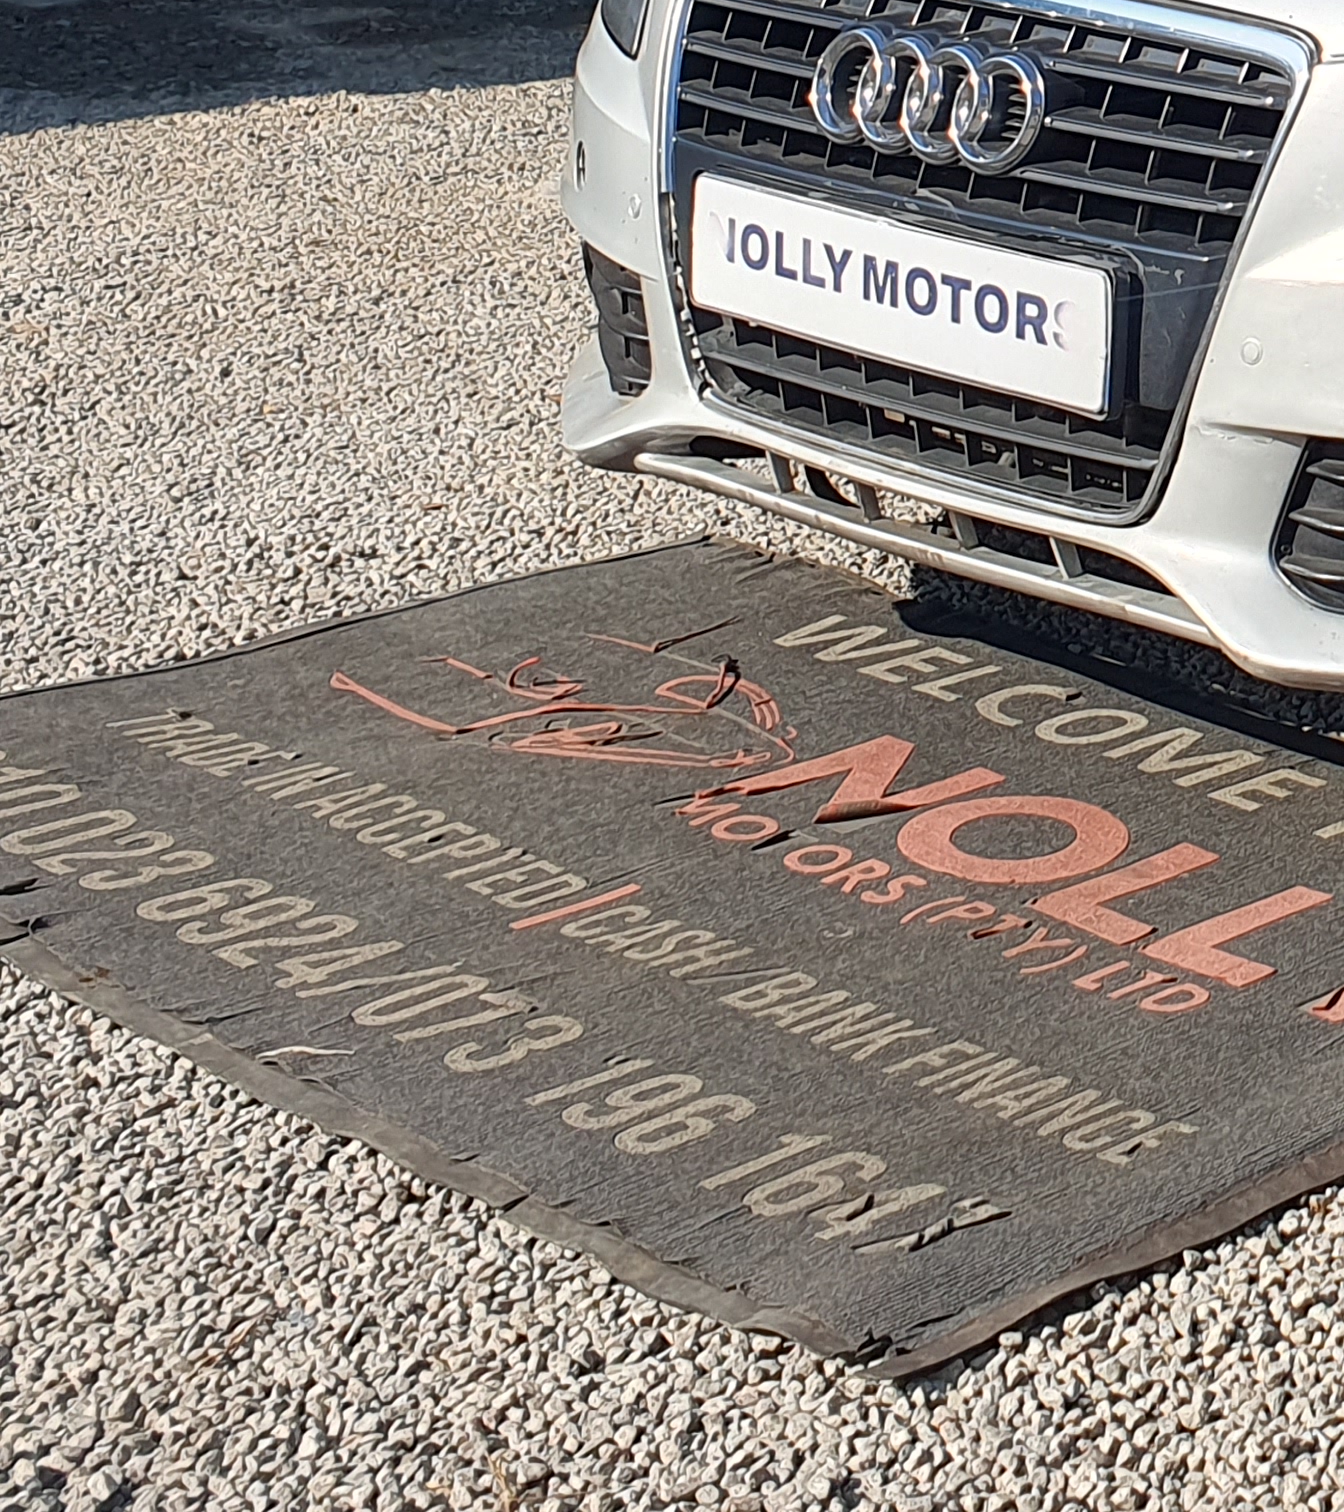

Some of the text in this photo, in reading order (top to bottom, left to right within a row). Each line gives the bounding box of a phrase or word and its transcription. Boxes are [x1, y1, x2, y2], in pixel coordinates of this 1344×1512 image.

[773, 614, 1327, 811] WELCOME
[0, 809, 216, 891] 023
[523, 1058, 757, 1155] 196
[1073, 960, 1211, 1013] LTD
[883, 1039, 1200, 1168] FINANCE
